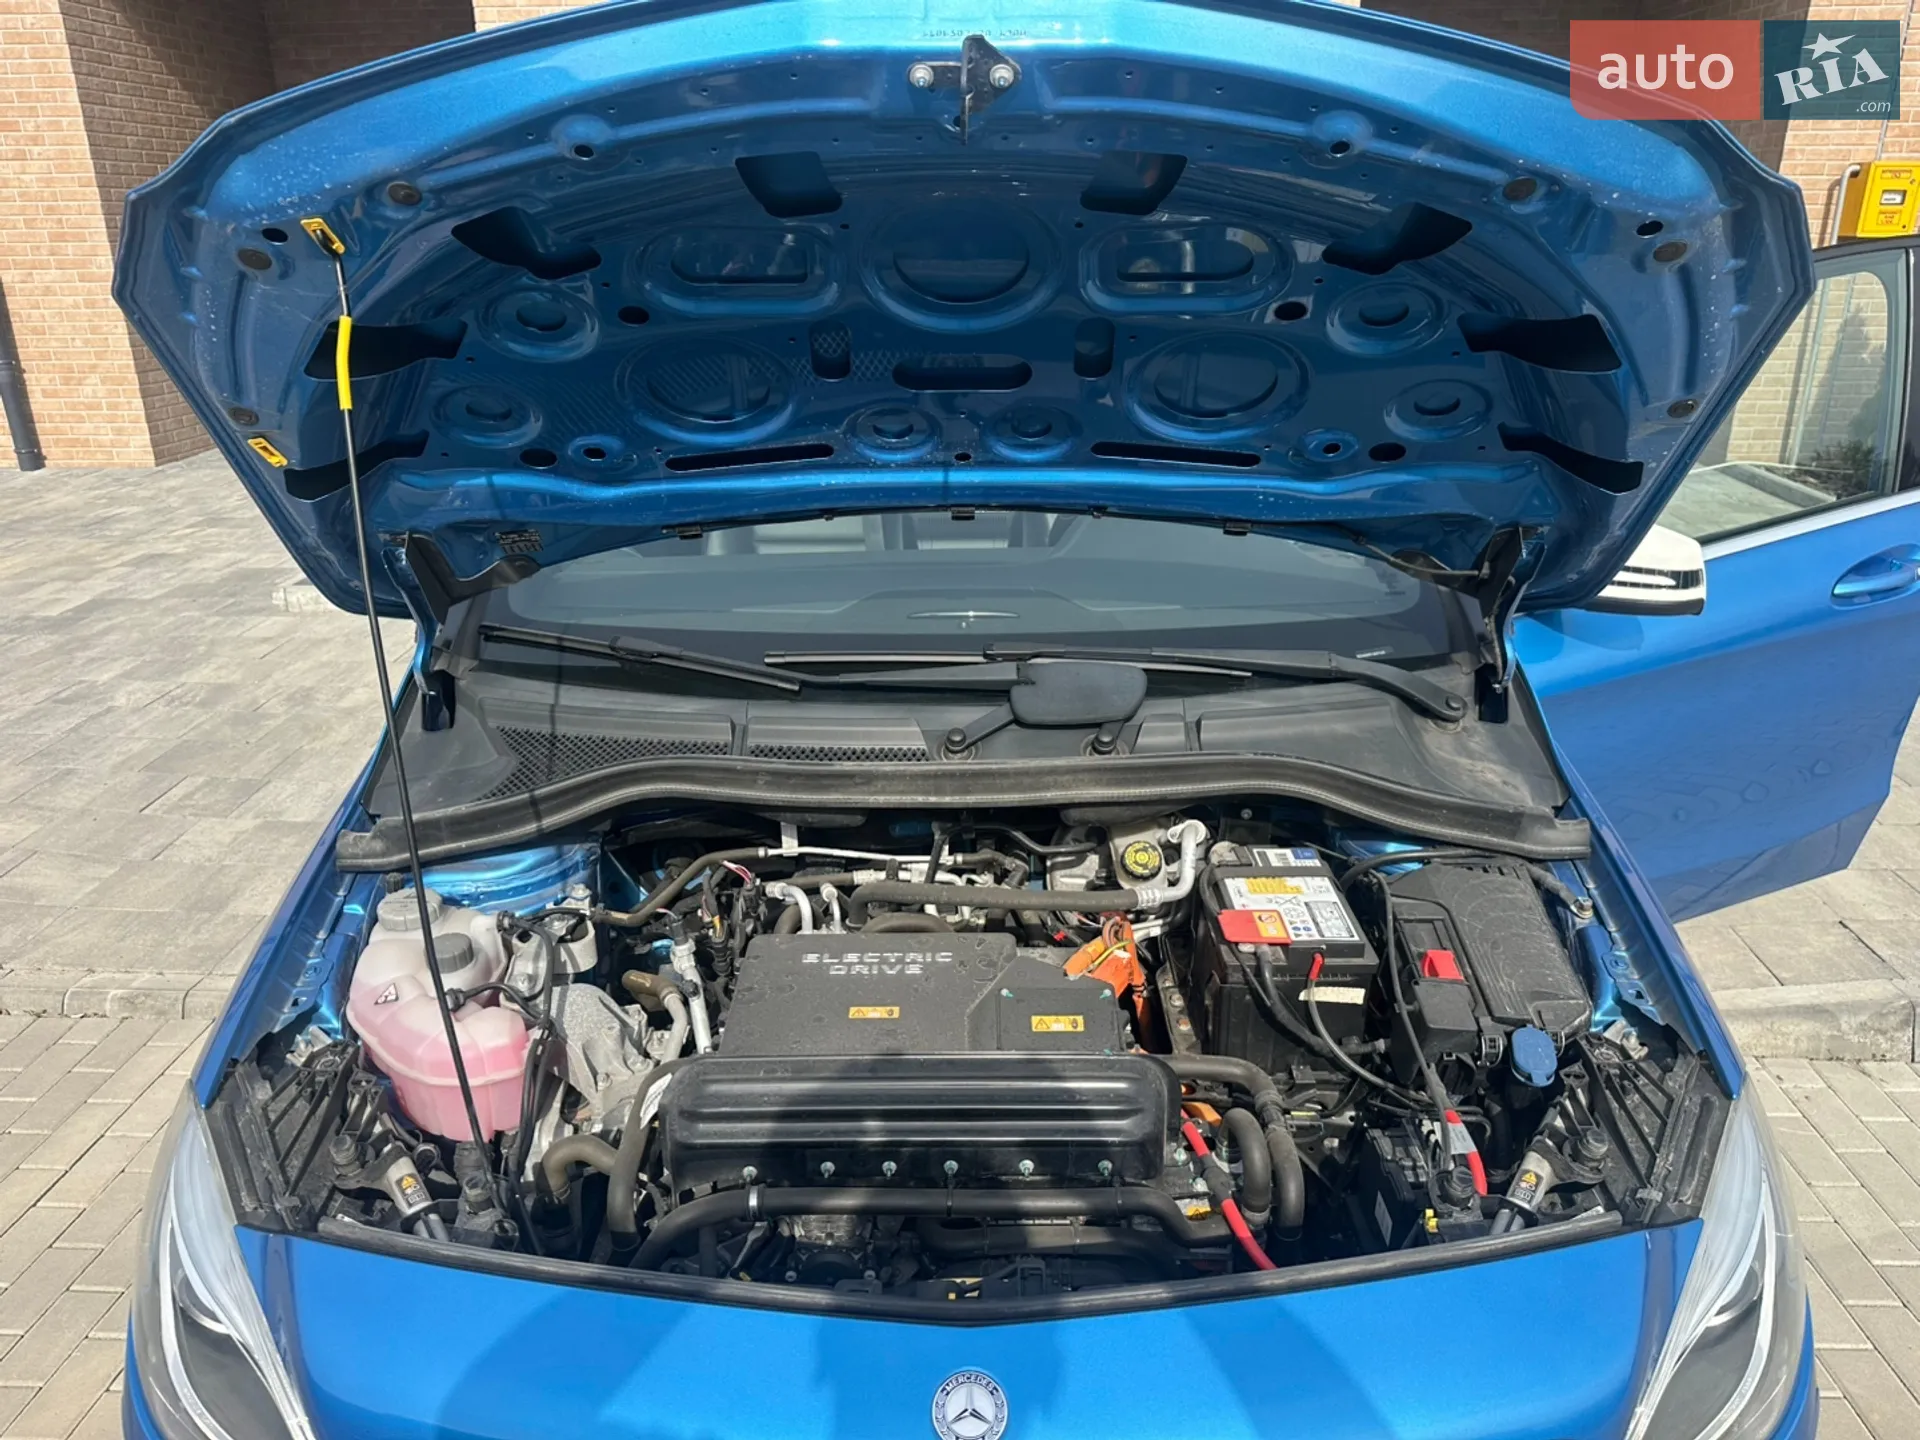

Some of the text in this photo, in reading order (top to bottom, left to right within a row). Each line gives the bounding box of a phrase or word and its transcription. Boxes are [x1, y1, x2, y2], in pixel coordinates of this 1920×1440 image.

[802, 952, 953, 963] ELECTRIC
[829, 964, 924, 975] DRIVE
[945, 1373, 995, 1391] MERCEDES
